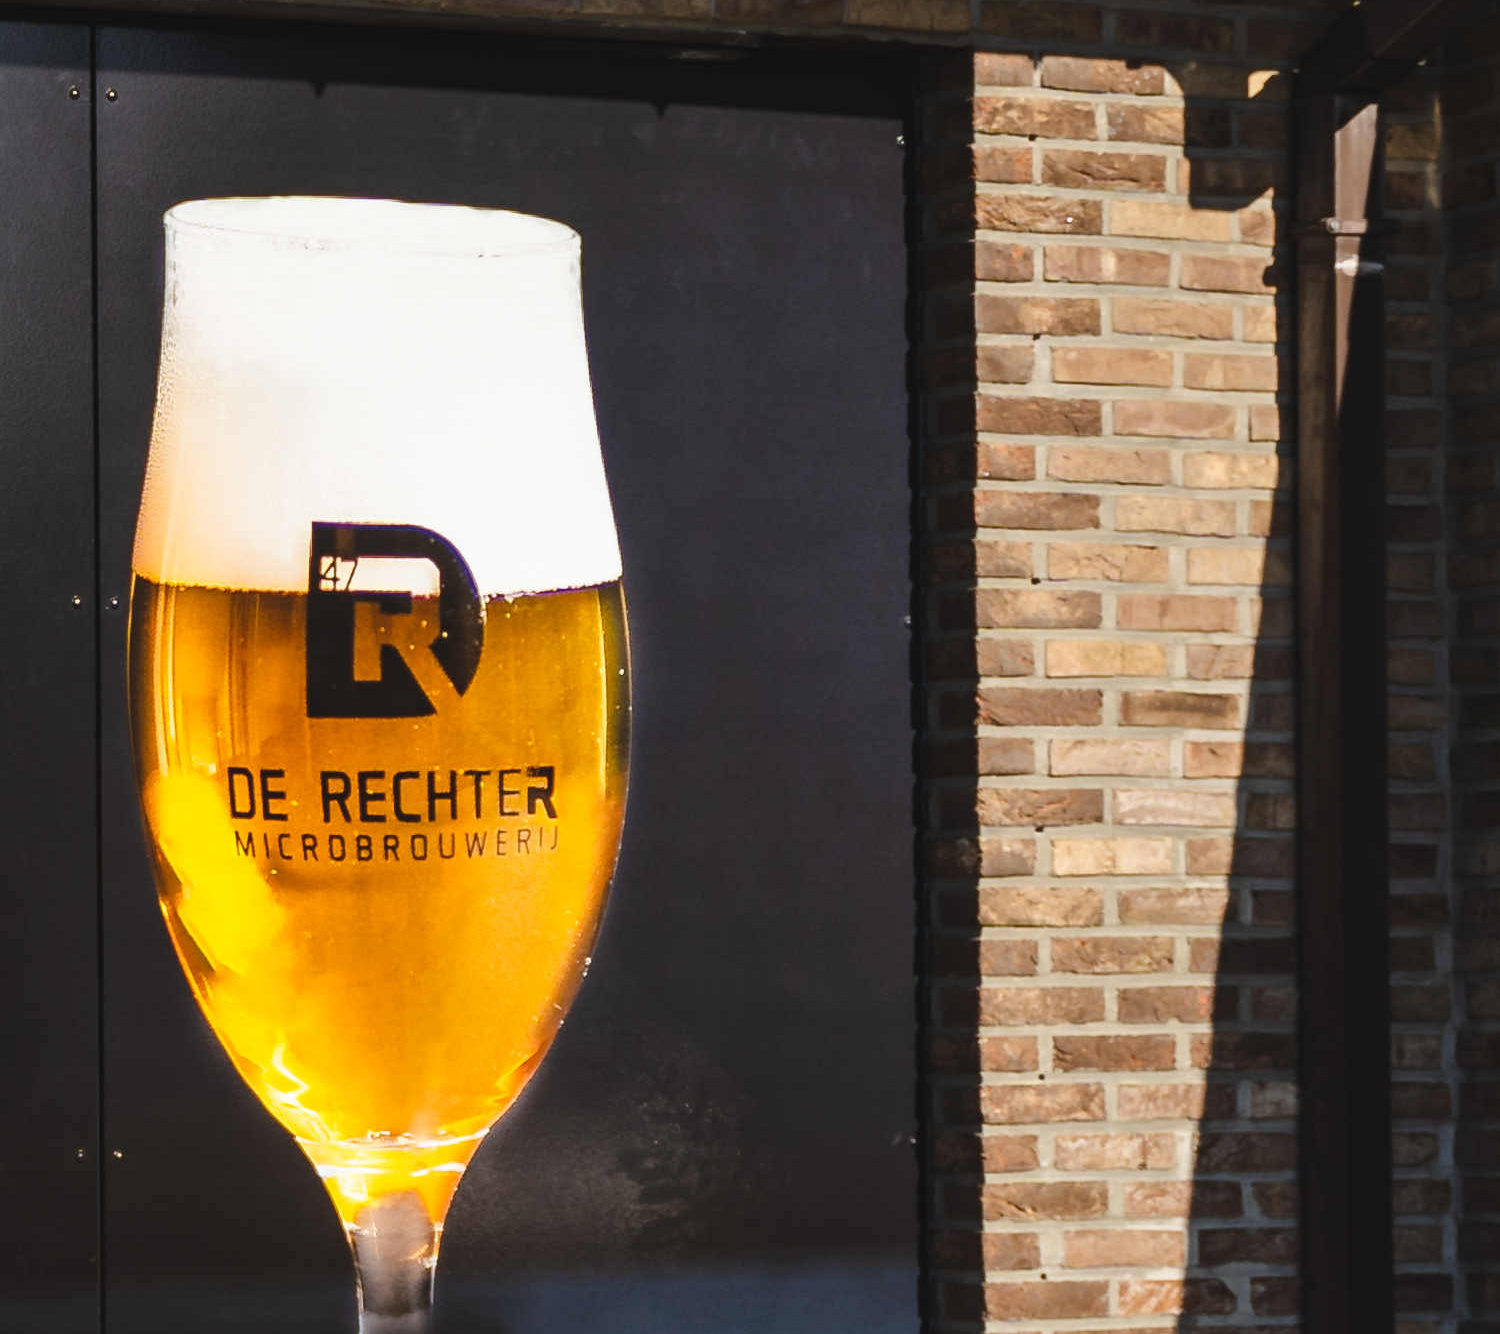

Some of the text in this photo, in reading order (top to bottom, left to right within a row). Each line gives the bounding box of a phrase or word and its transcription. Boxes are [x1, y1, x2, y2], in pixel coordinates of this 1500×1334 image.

[227, 765, 558, 824] DE RECHTER
[234, 825, 561, 862] MICROBROUWERIJ
